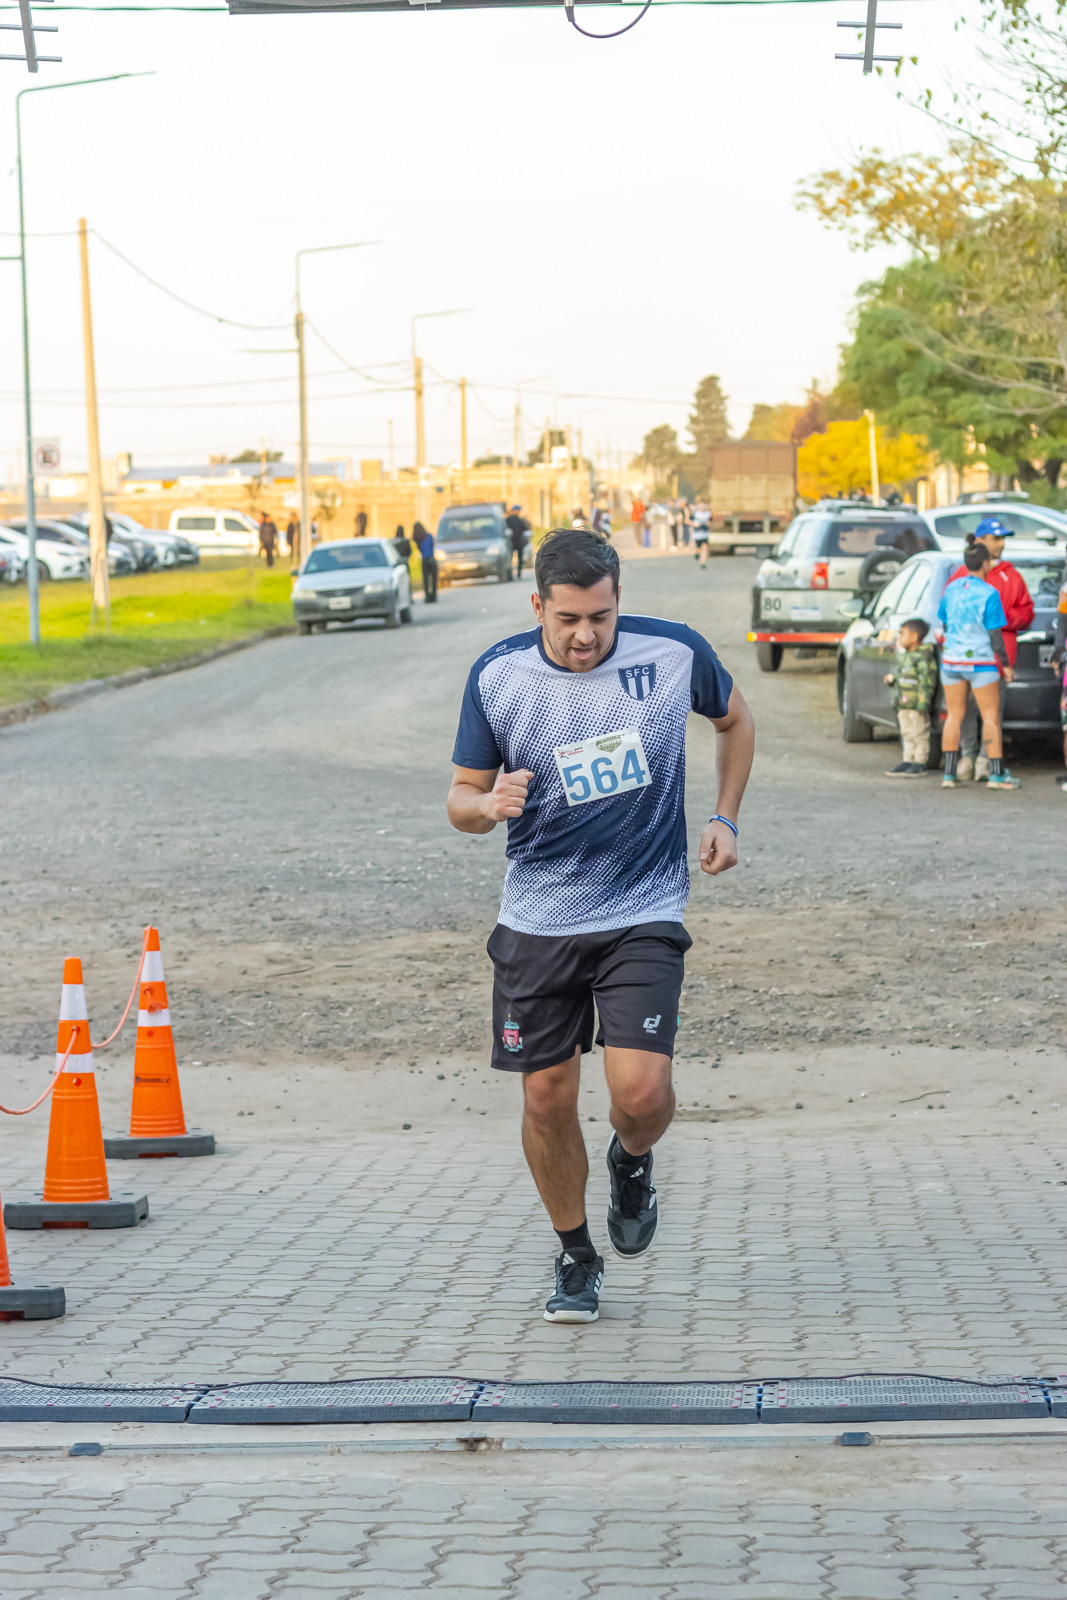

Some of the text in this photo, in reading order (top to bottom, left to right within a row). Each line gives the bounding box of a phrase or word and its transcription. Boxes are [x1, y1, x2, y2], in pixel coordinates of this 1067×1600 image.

[764, 597, 782, 611] 80
[625, 666, 650, 678] SFC
[562, 748, 646, 801] 564
